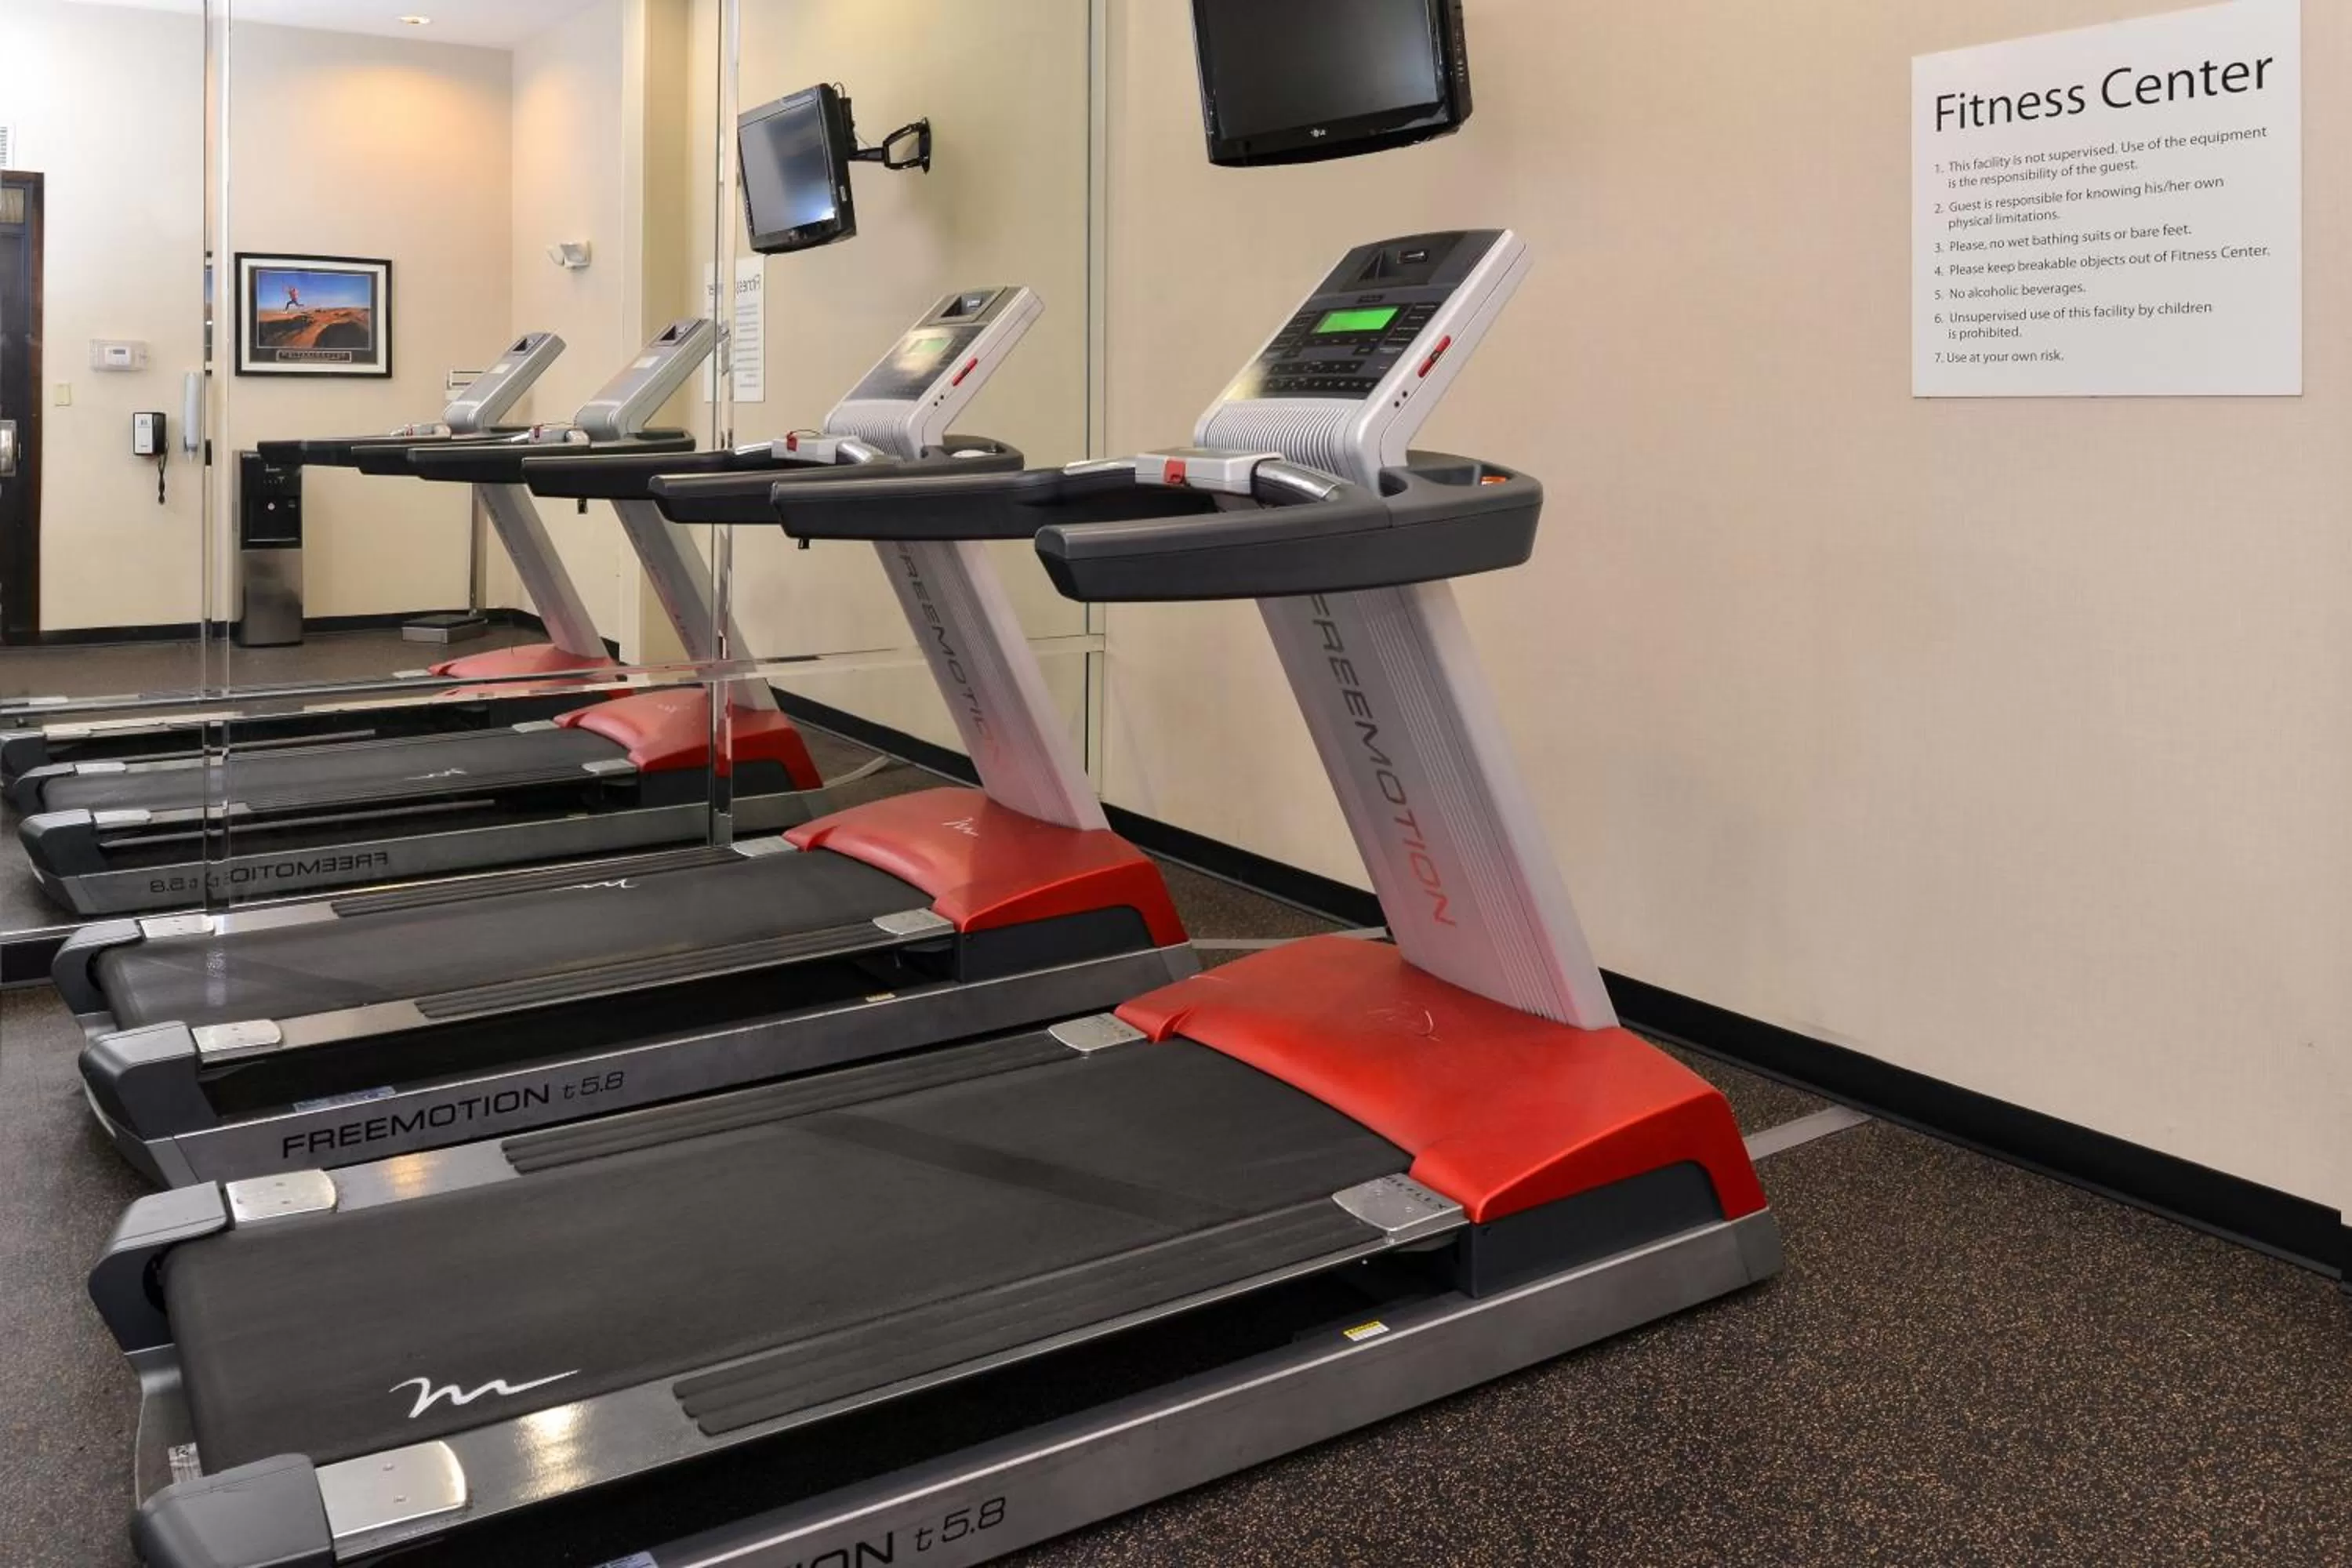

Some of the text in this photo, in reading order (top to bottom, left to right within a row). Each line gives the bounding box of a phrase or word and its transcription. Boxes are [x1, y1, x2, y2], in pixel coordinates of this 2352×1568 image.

[1936, 56, 2273, 132] Fitness Center
[1935, 127, 2267, 173] 1. This facility is not supervised. Use of the equipment
[1948, 160, 2137, 188] is the responsibility of the guest.
[1935, 178, 2223, 213] 2. Guest is responsible for knowing his/her own
[1948, 207, 2060, 231] physical limitations.
[1934, 242, 1944, 252] 3.
[2007, 238, 2029, 248] wet
[2032, 233, 2080, 245] bathing
[2082, 230, 2111, 242] suits
[2114, 230, 2127, 239] or
[2130, 226, 2160, 238] bare
[2163, 223, 2191, 236] feet.
[1935, 246, 2270, 276] 4. Please keep breakable objects out of Fitness Center.
[1935, 284, 2085, 299] 5. No alcoholic beverages.
[1934, 301, 2212, 328] 6. Unsupervised use of this facility by children
[1947, 326, 2021, 341] is prohibited.
[1935, 350, 2063, 364] 7. Use at your own risk.
[1311, 593, 1456, 927] FREEMOTION
[282, 1083, 550, 1159] FREEMOTION
[562, 1071, 624, 1099] t5.8
[915, 1497, 1006, 1552] t5.8
